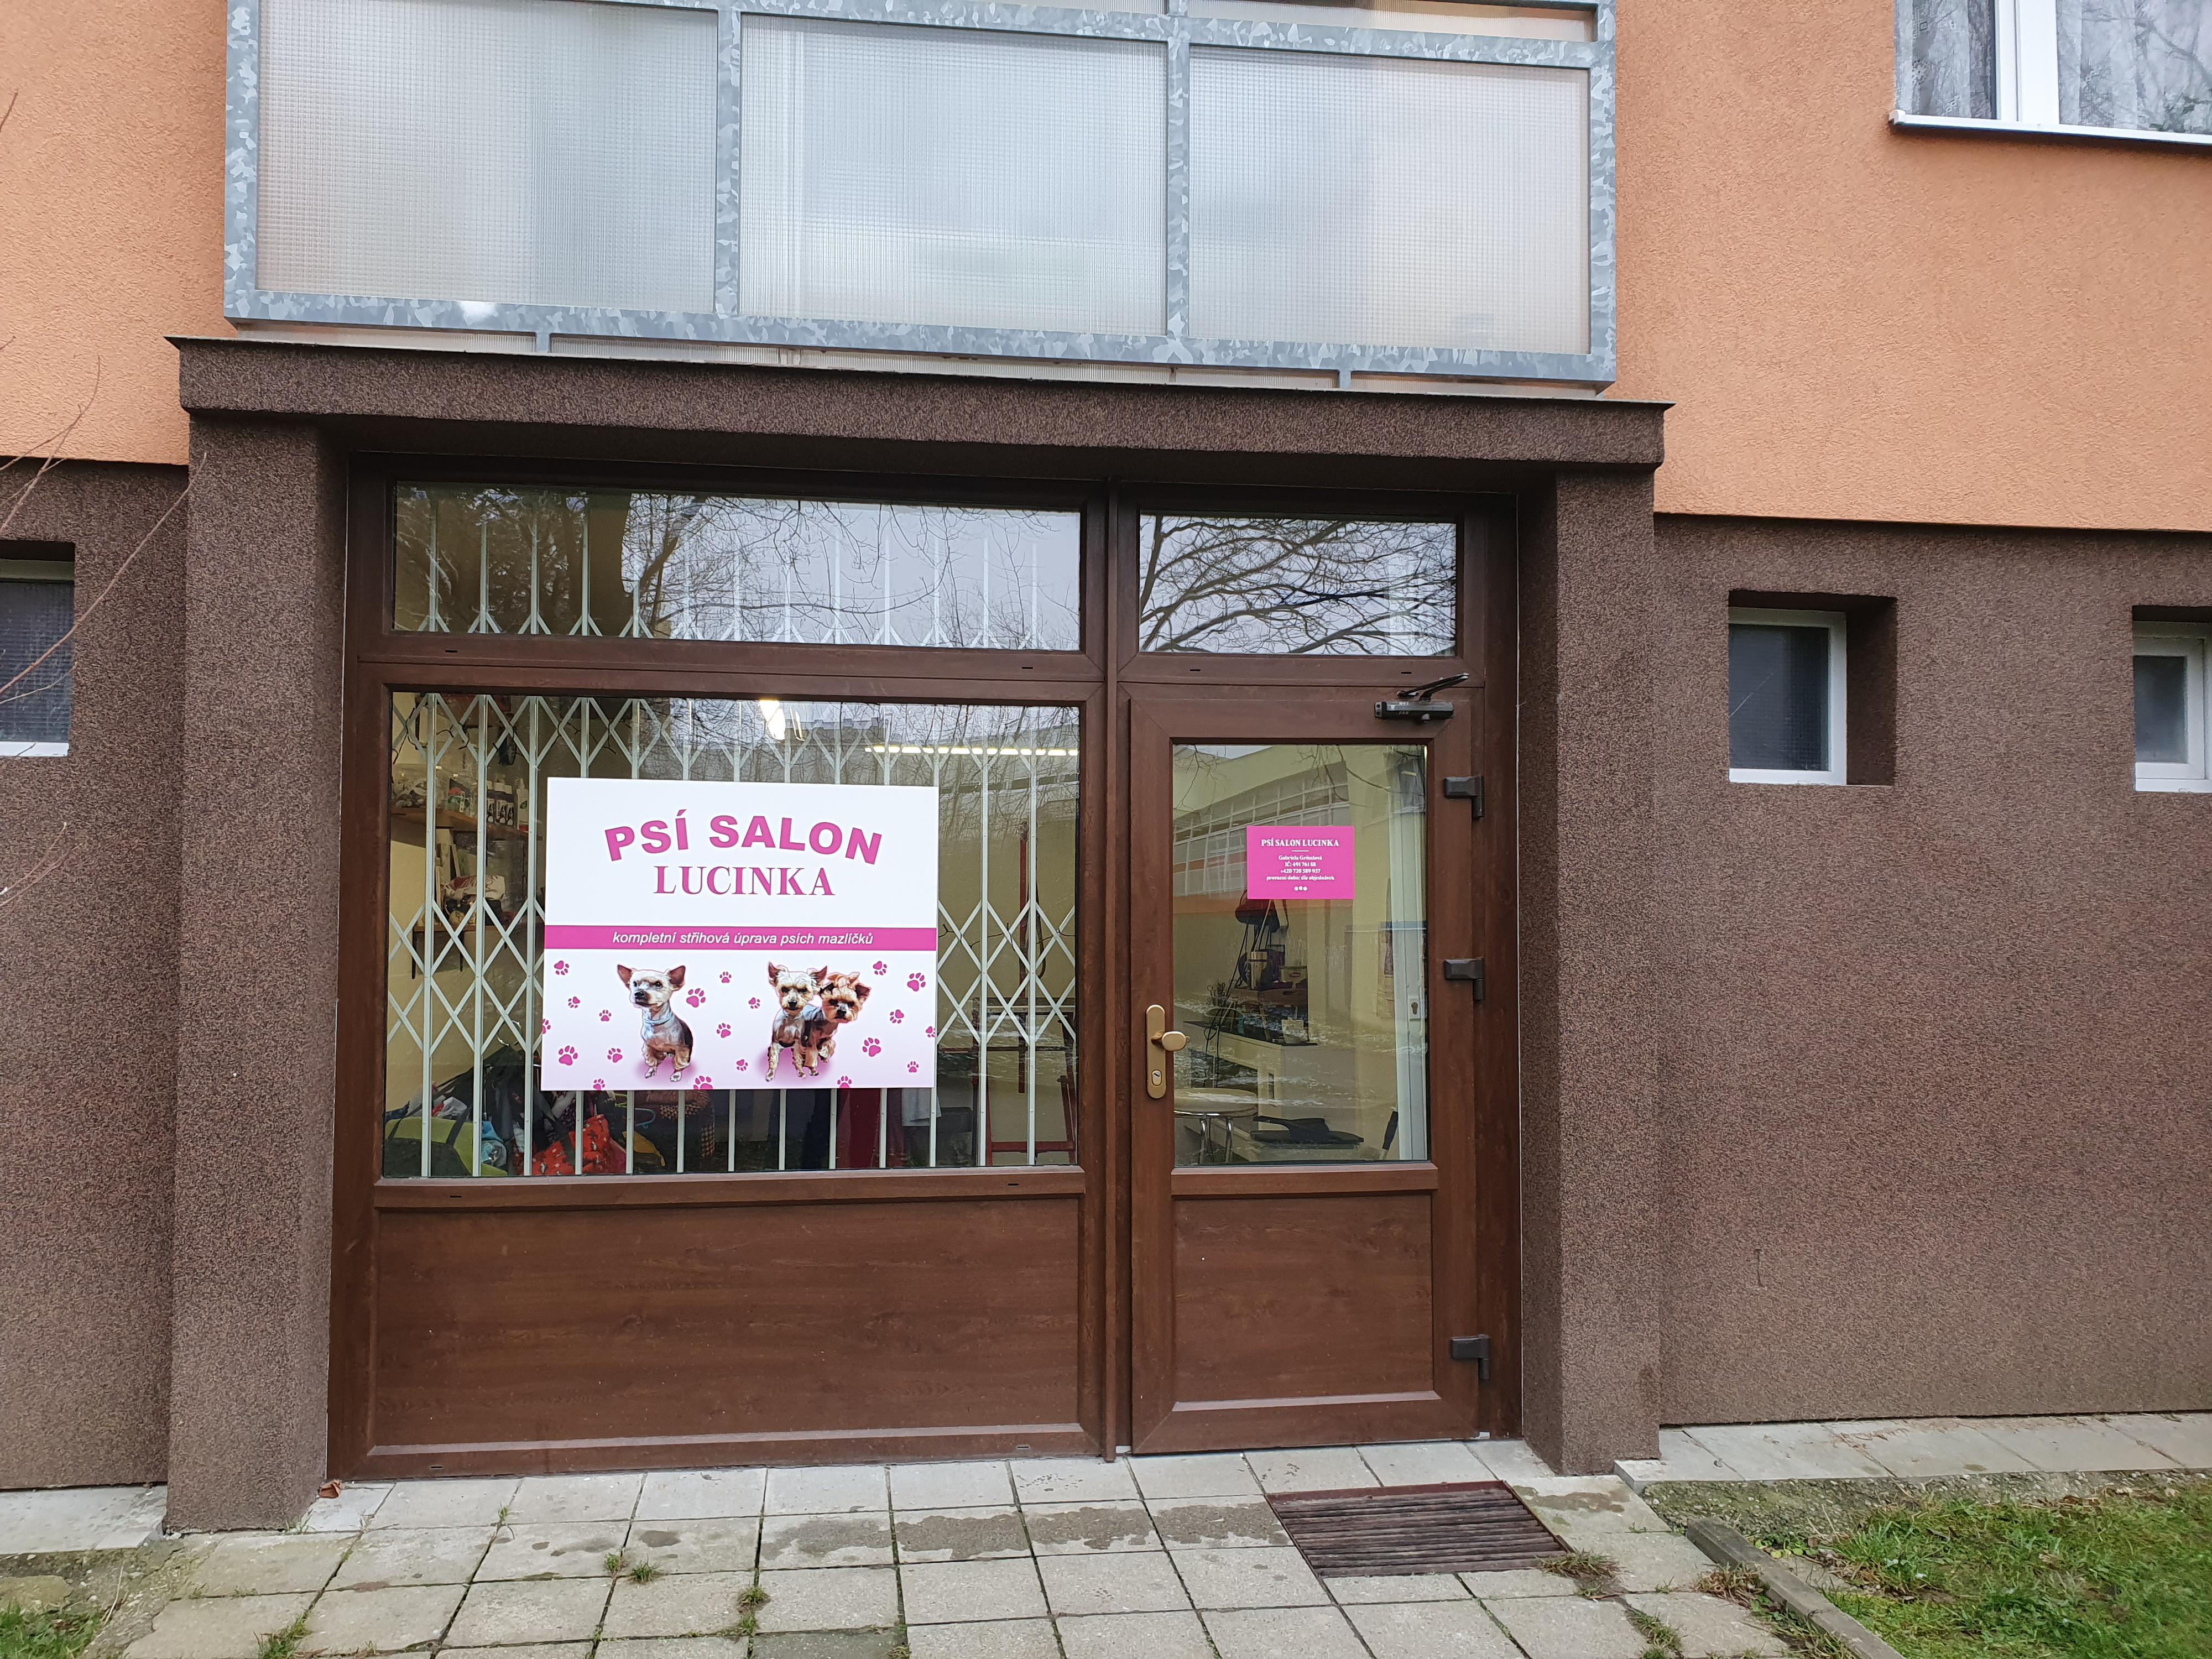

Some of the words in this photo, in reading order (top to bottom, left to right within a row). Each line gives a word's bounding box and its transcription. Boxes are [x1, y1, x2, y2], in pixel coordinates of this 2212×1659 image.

[604, 808, 690, 862] PSÍ
[709, 815, 883, 865] SALON
[1261, 837, 1274, 847] PSÍ
[653, 865, 836, 896] LUCINKA
[612, 931, 677, 946] kompletní
[679, 931, 730, 944] střihová
[733, 931, 777, 946] úprava
[780, 932, 815, 947] psích
[818, 932, 874, 945] mazlíčků
